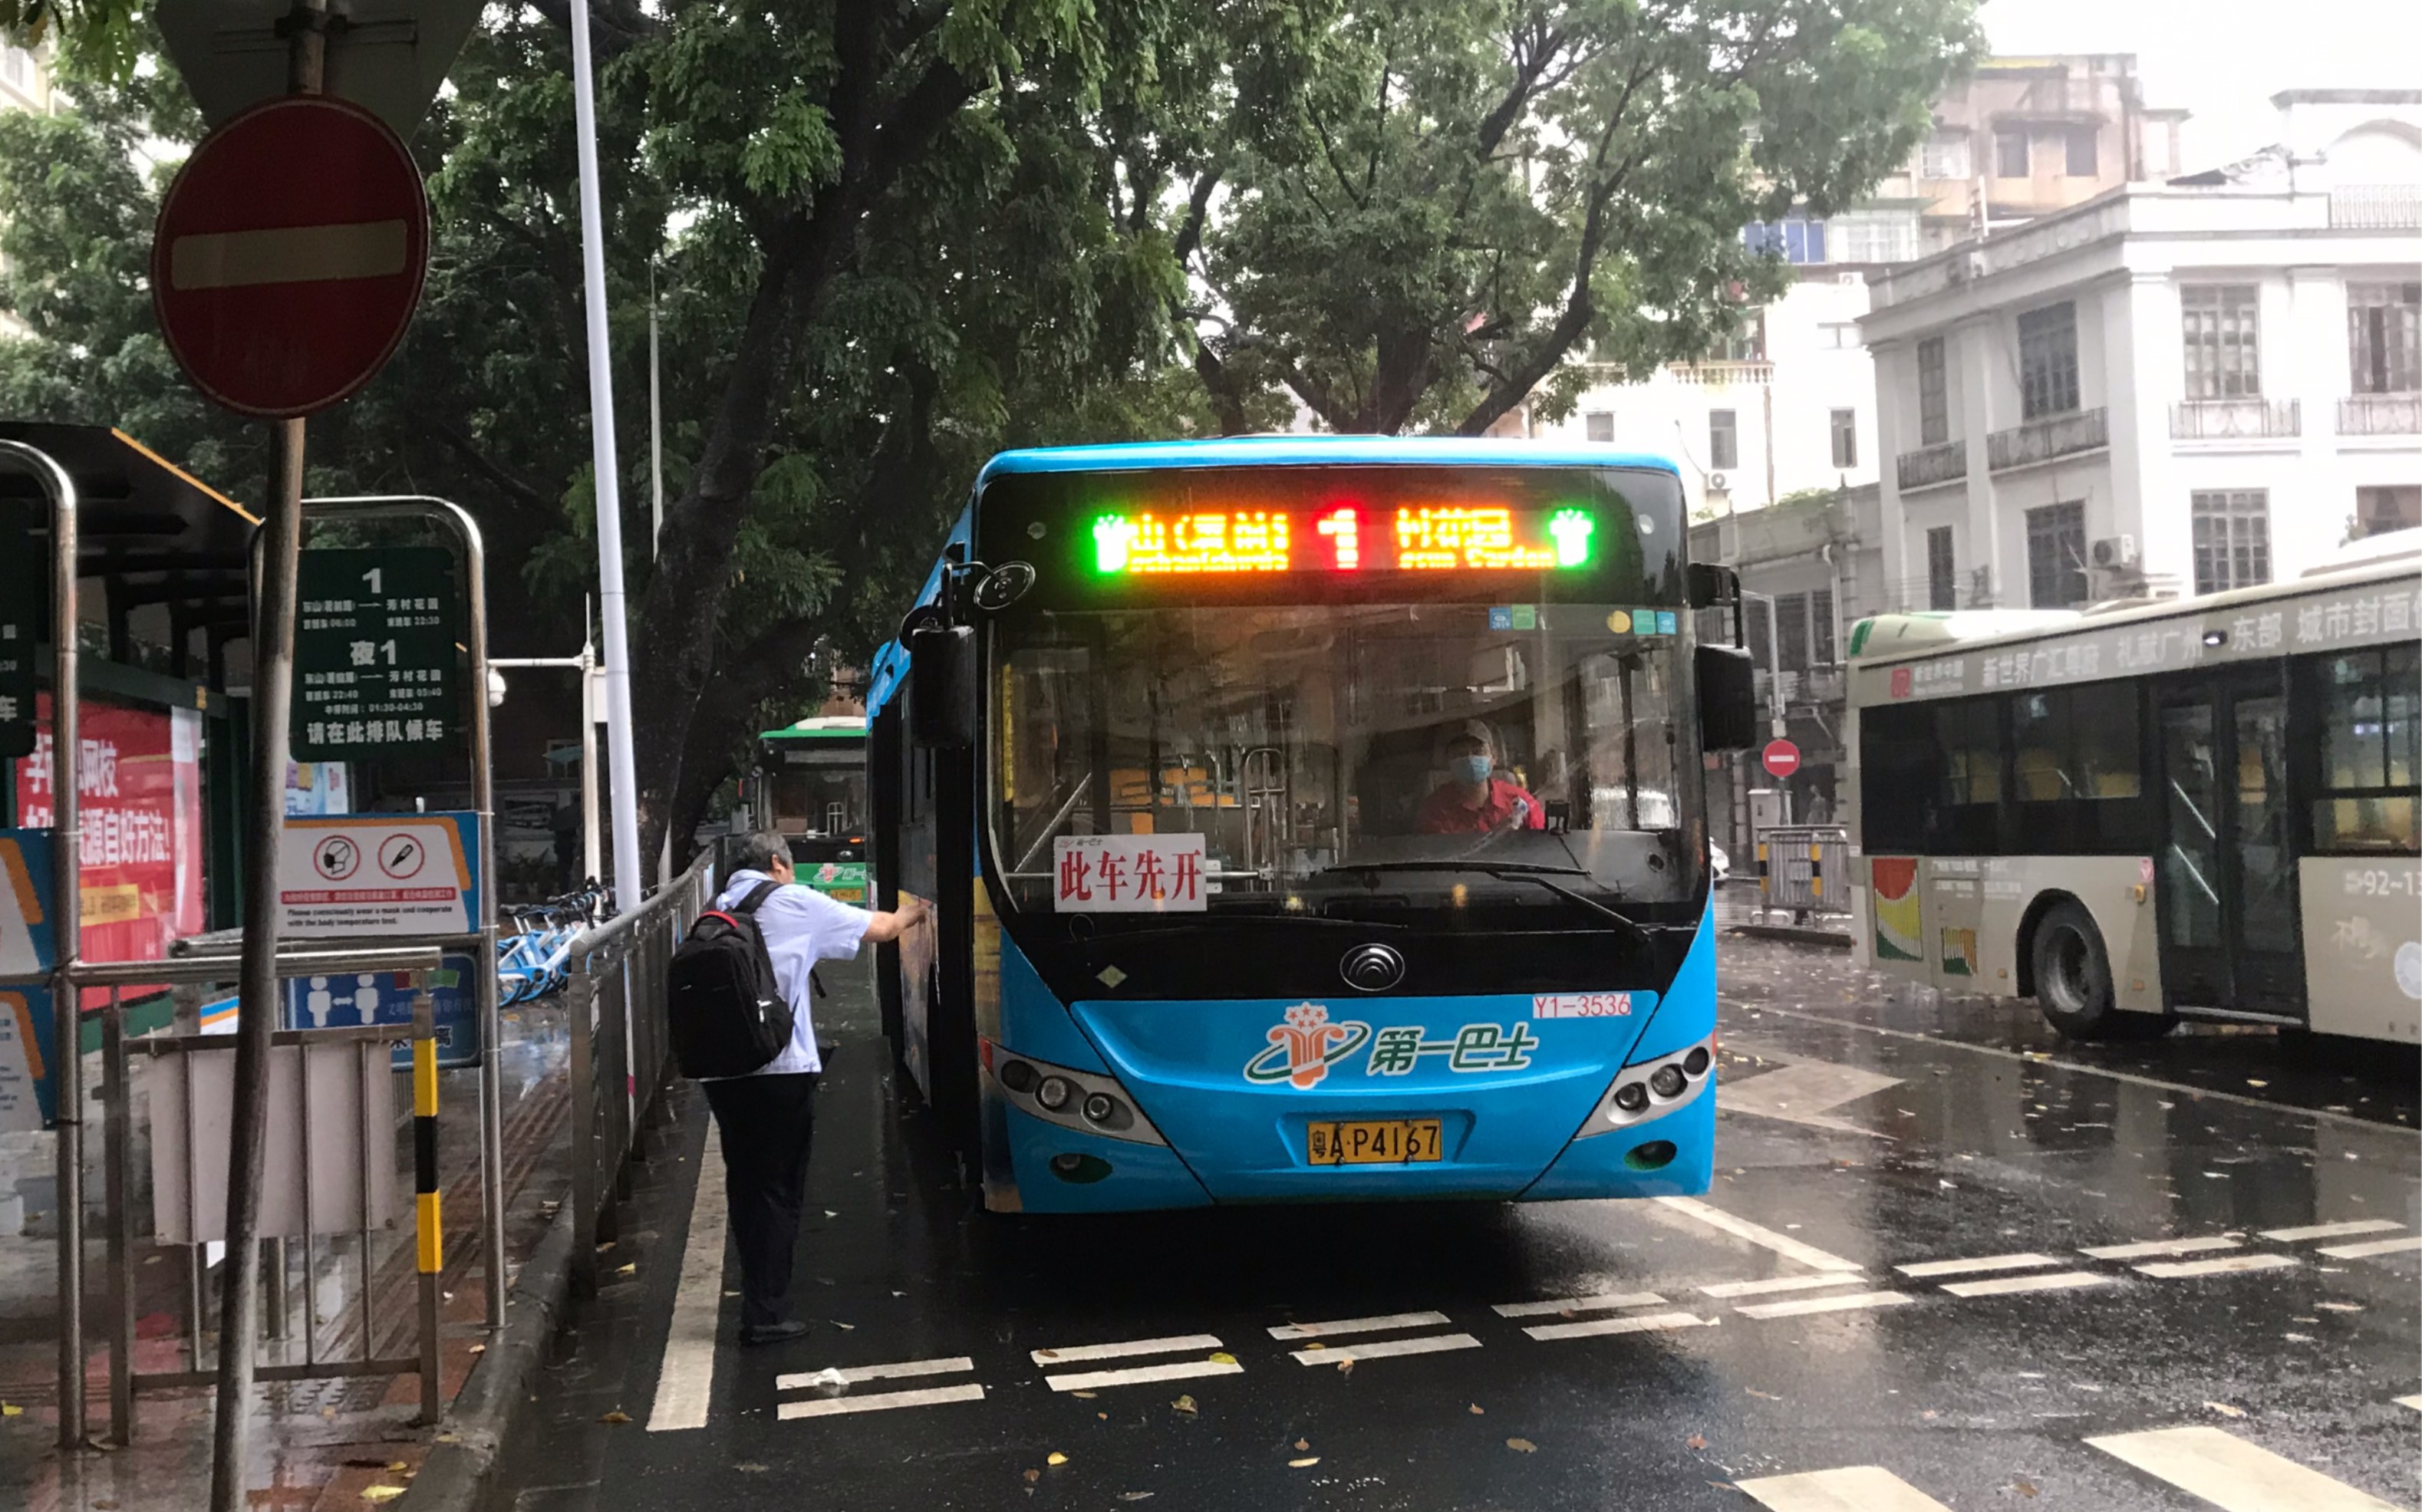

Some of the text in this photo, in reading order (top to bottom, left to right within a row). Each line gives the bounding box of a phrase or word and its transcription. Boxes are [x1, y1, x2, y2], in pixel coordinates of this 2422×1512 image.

[1317, 509, 1359, 569] 1
[362, 567, 381, 594] 1
[307, 719, 443, 744] 请在此排队候车
[1060, 848, 1203, 901] 此车先开
[1535, 993, 1632, 1019] Y1-3536
[1369, 1023, 1537, 1073] 第一巴士
